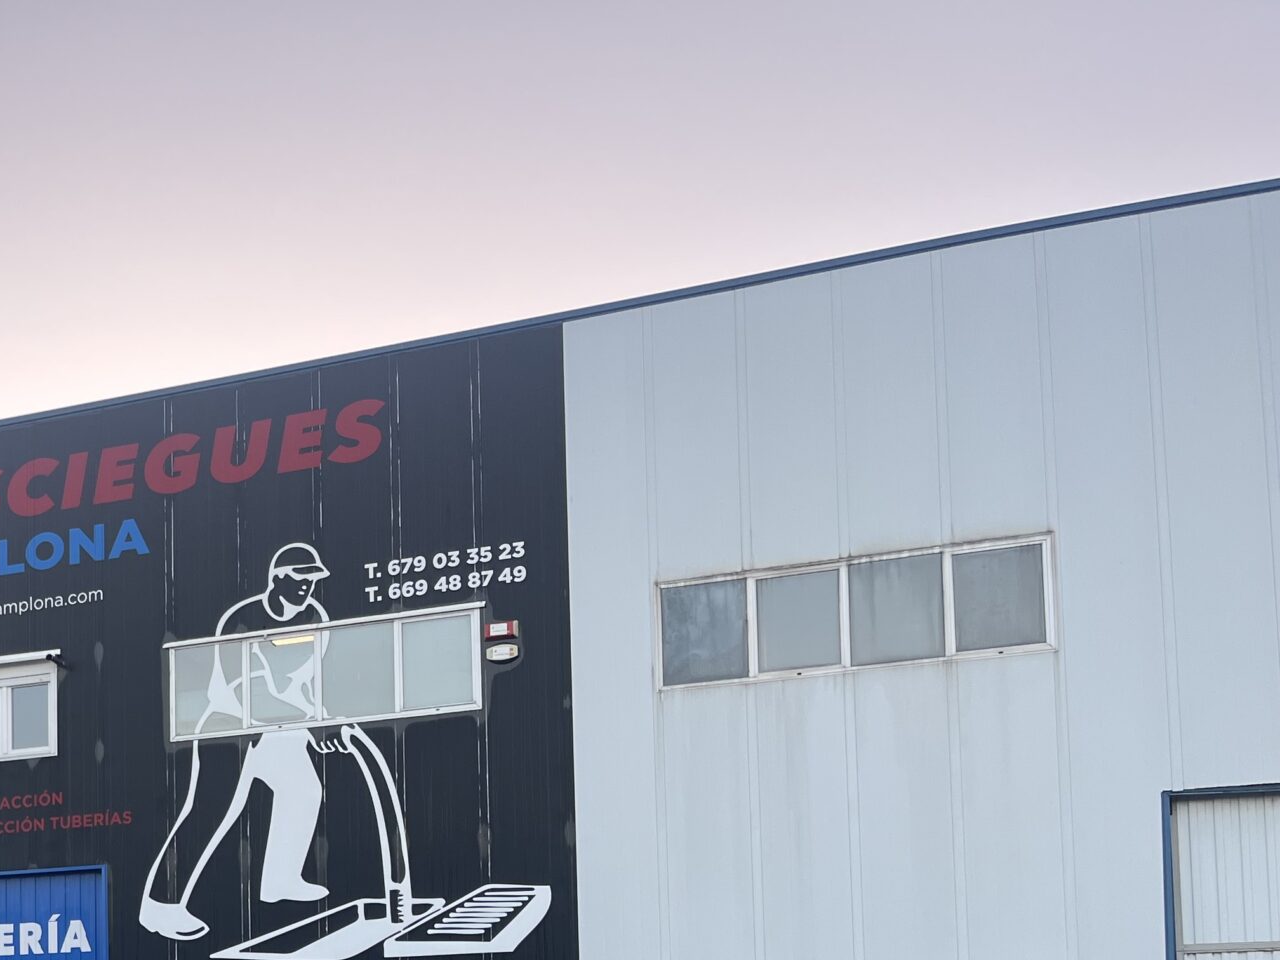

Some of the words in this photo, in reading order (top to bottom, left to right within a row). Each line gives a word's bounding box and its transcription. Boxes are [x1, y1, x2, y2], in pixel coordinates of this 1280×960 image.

[364, 562, 382, 579] T.
[387, 555, 427, 576] 679
[432, 550, 461, 569] 03
[466, 545, 492, 565] 35
[498, 541, 525, 560] 23
[365, 585, 383, 602] T.
[388, 579, 428, 599] 669
[433, 574, 462, 592] 48
[467, 570, 494, 589] 87
[498, 565, 527, 584] 49
[50, 809, 133, 830] TUBERÍAS
